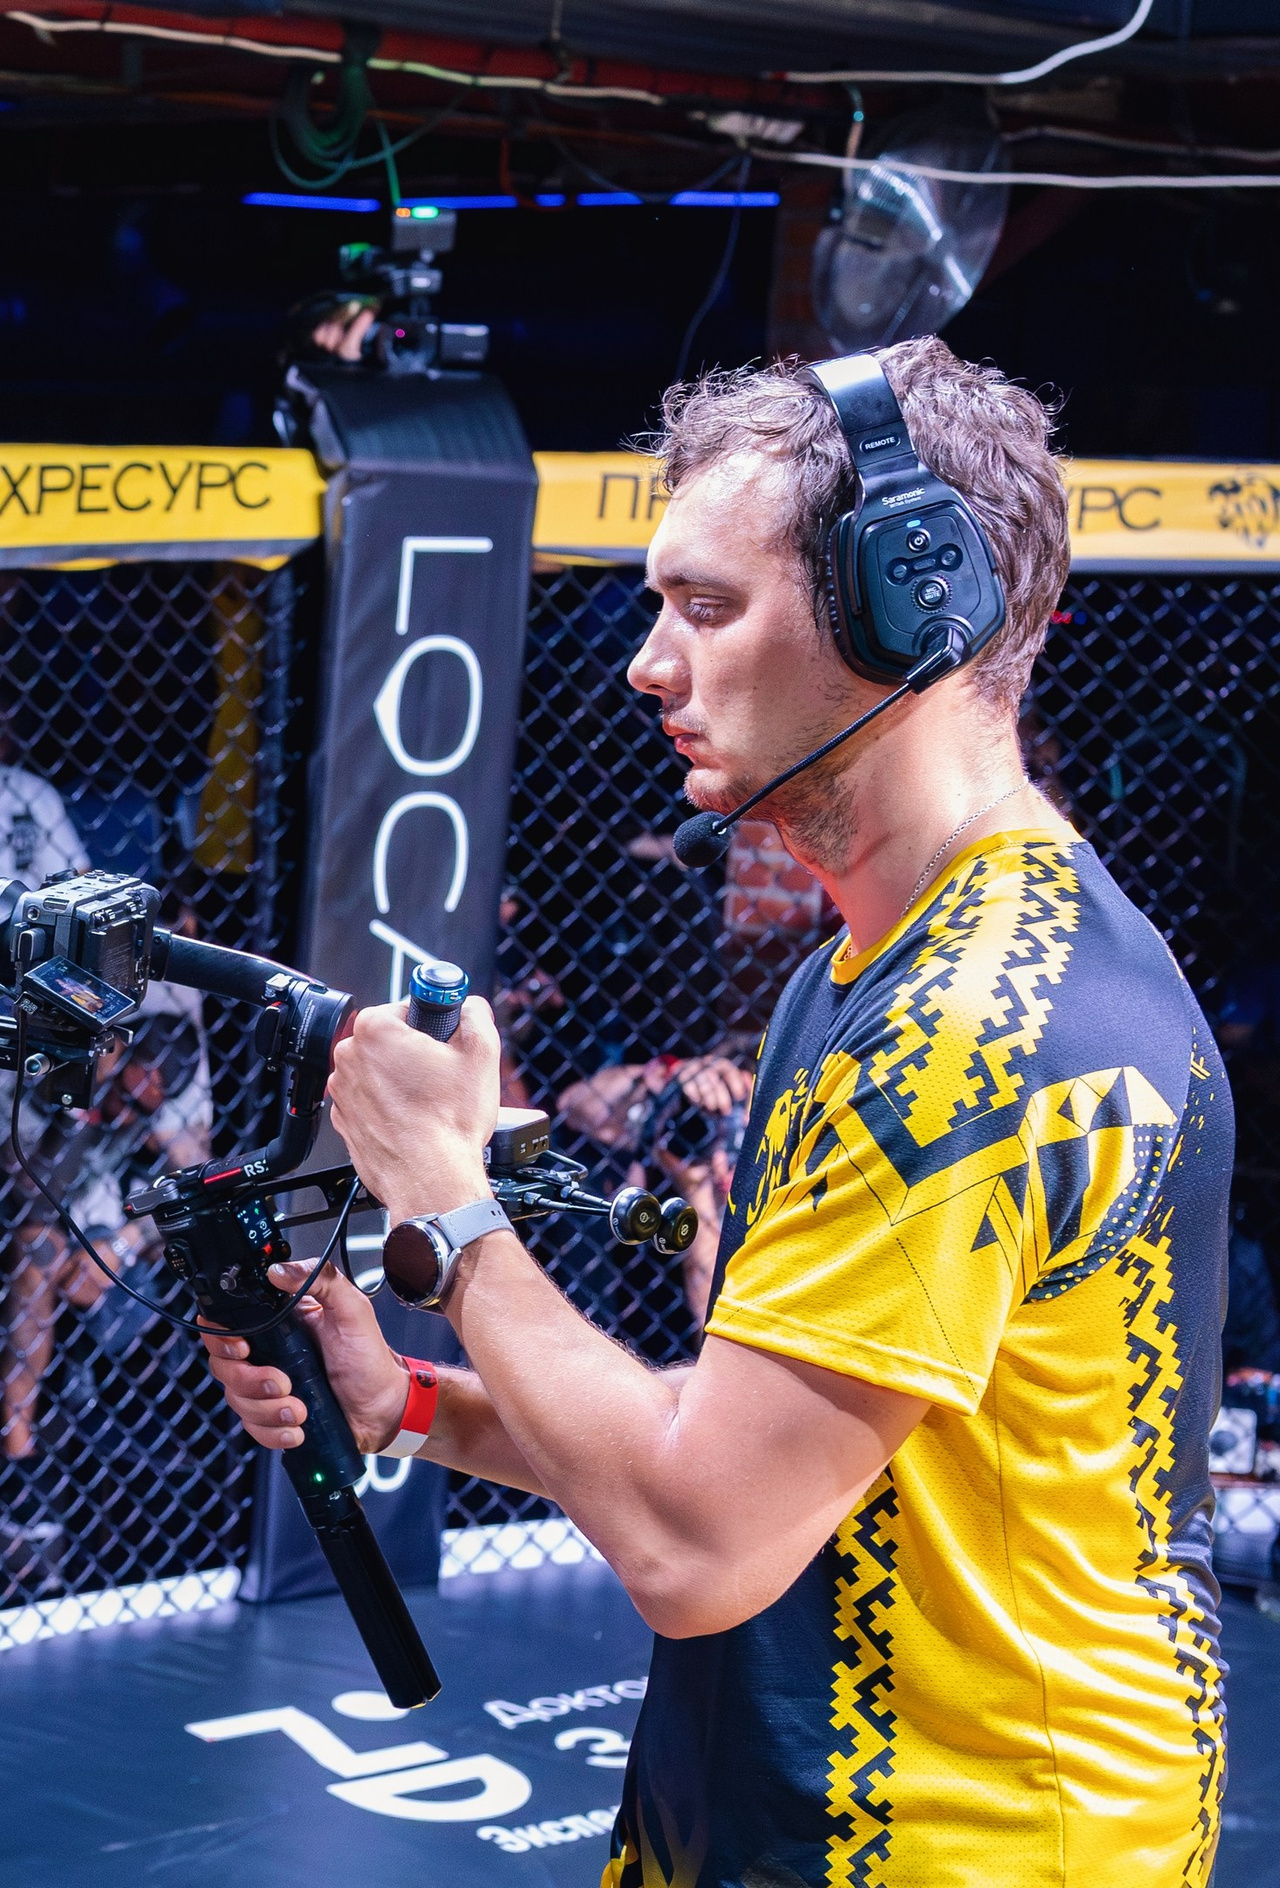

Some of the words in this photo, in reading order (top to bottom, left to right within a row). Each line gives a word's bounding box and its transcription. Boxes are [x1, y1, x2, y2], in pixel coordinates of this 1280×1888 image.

[864, 436, 896, 450] REMOTE
[881, 487, 926, 506] Saramonic
[243, 1159, 269, 1177] RS
[482, 1676, 649, 1730] Докто
[476, 1804, 621, 1853] Экспе
